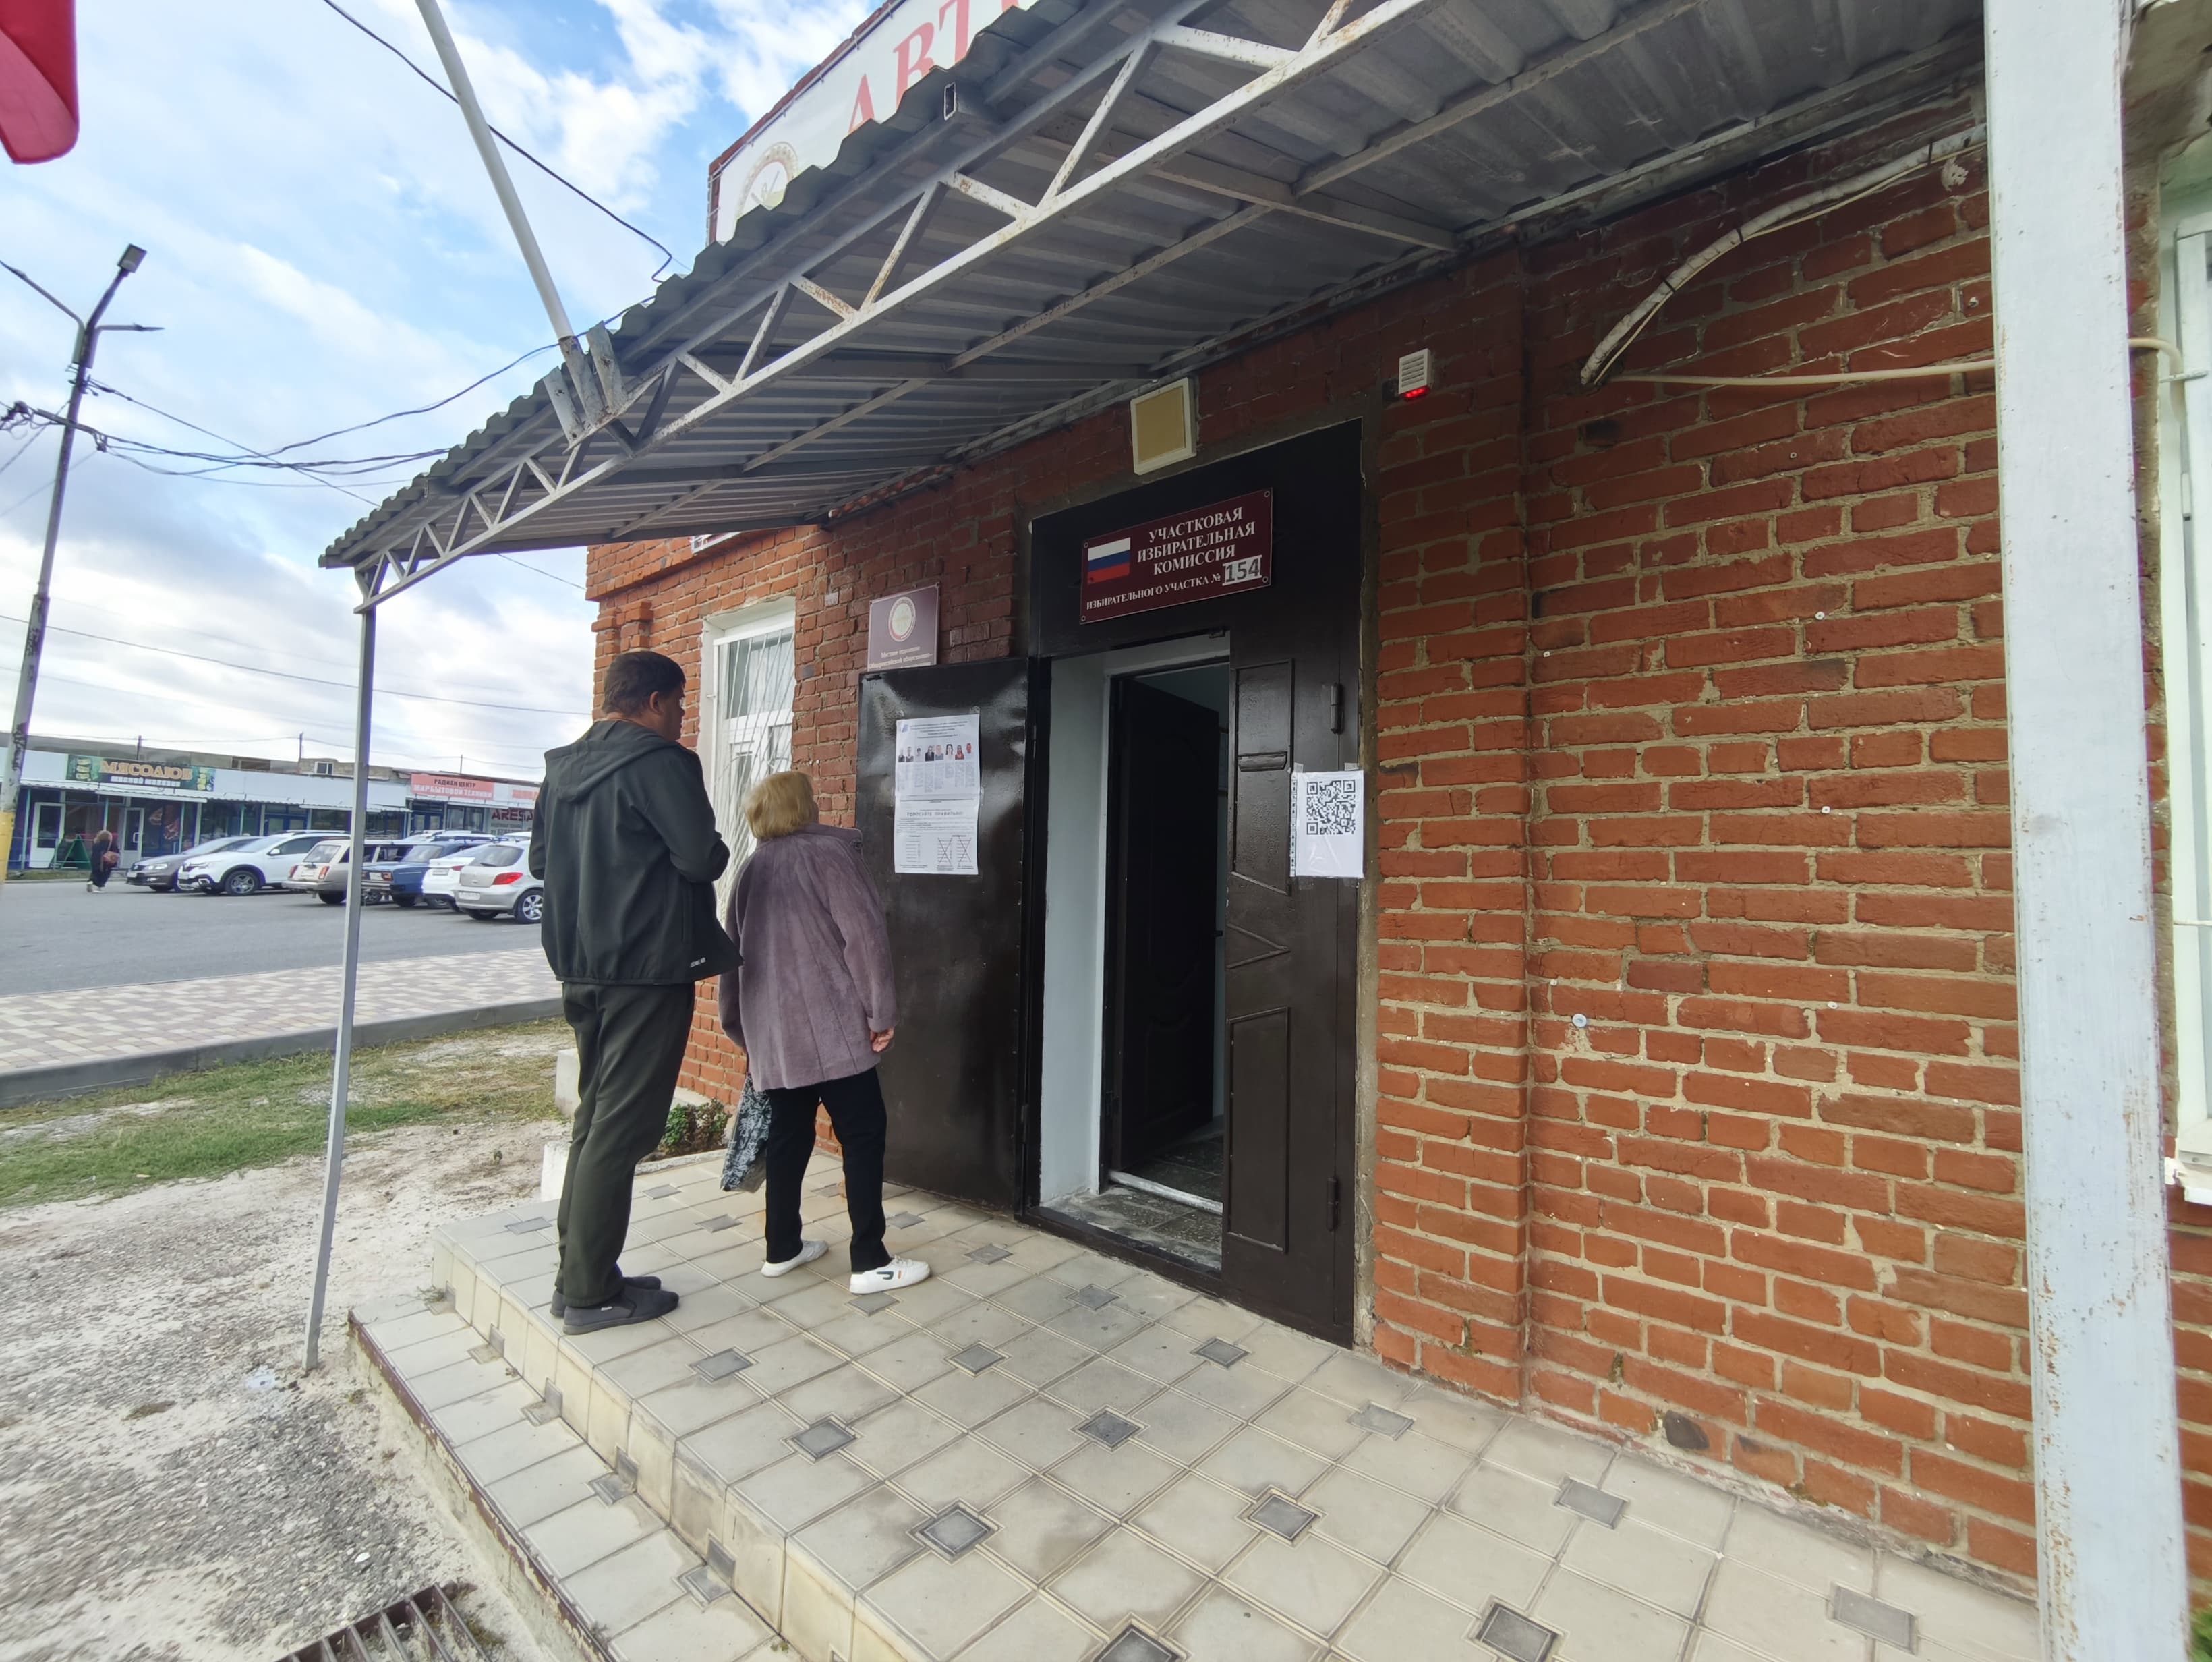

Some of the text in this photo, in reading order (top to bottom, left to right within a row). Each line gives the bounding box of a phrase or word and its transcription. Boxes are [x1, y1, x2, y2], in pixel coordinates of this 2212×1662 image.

[848, 0, 1019, 135] АВТ
[1138, 521, 1256, 563] ИЗБИРАТЕЛЬНАЯ
[1149, 507, 1243, 543] УЧАСТКОВАЯ
[1154, 544, 1235, 575] КОМИССИЯ
[1086, 558, 1260, 610] ИЗБИРАТЕЛЬНОГО УЧАСТКА № 154
[100, 761, 192, 780] МЯСОЛЮБ
